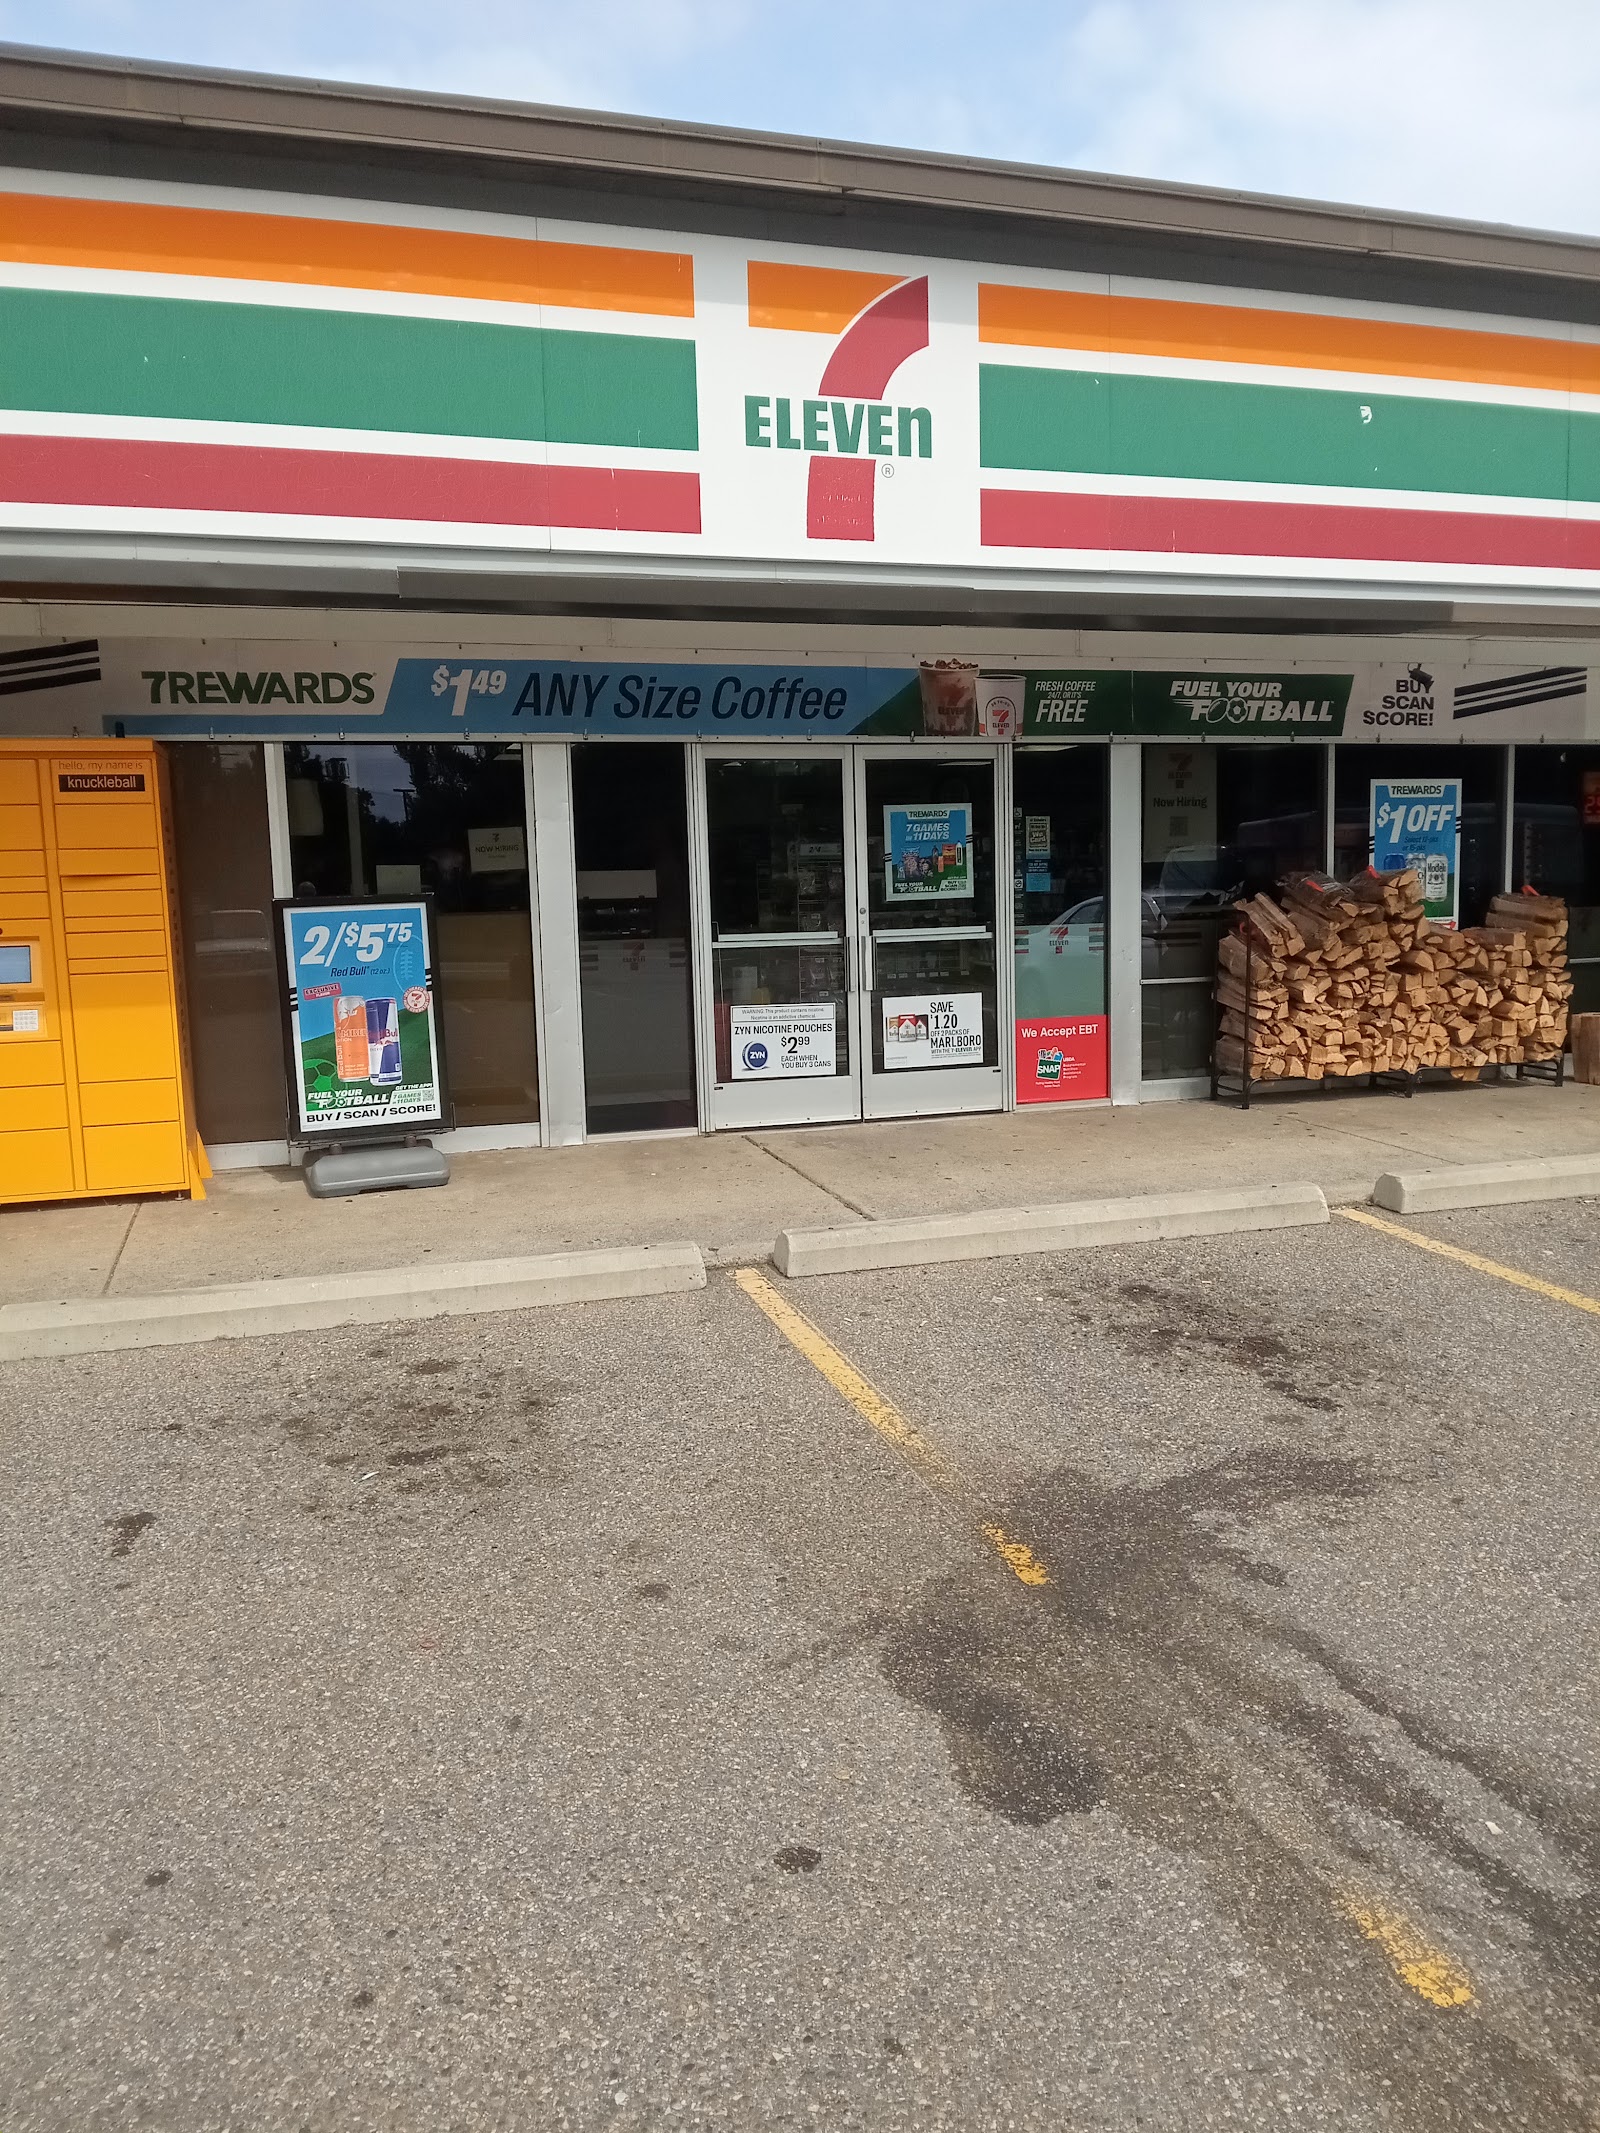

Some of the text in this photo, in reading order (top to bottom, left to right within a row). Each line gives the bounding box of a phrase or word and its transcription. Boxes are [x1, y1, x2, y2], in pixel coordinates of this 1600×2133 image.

[747, 260, 929, 541] 7
[141, 671, 376, 704] 7REWARDS
[1035, 681, 1096, 692] FRESH COFFEE
[1169, 680, 1282, 698] FUEL YOUR
[1396, 680, 1434, 693] BUY
[512, 673, 847, 719] ANY Size Coffee
[1382, 696, 1434, 710] SCAN
[1035, 699, 1088, 723] FREE
[1363, 711, 1433, 726] SCORE!
[88, 762, 103, 771] my
[105, 762, 132, 770] name
[135, 760, 143, 769] is
[67, 775, 136, 788] knuckleball
[1391, 785, 1442, 795] 7REWARDS
[1153, 796, 1207, 808] Now Hiring
[906, 823, 950, 832] 7 GAMES
[1377, 802, 1454, 844] $1 OFF
[913, 833, 922, 841] 11
[923, 831, 949, 840] DAYS
[330, 967, 348, 977] Red
[930, 1001, 954, 1013] SAVE
[734, 1023, 832, 1035] ZYN NICOTINE POUCHES
[1021, 1024, 1098, 1038] We Accept EBT
[930, 1034, 981, 1048] MARLBORO
[749, 1051, 765, 1059] ZYN
[1037, 1065, 1060, 1074] SNAP
[307, 1089, 362, 1099] FUEL YOUR
[306, 1113, 333, 1123] BUY
[343, 1109, 379, 1119] SCAN
[389, 1104, 436, 1115] SCORE!
